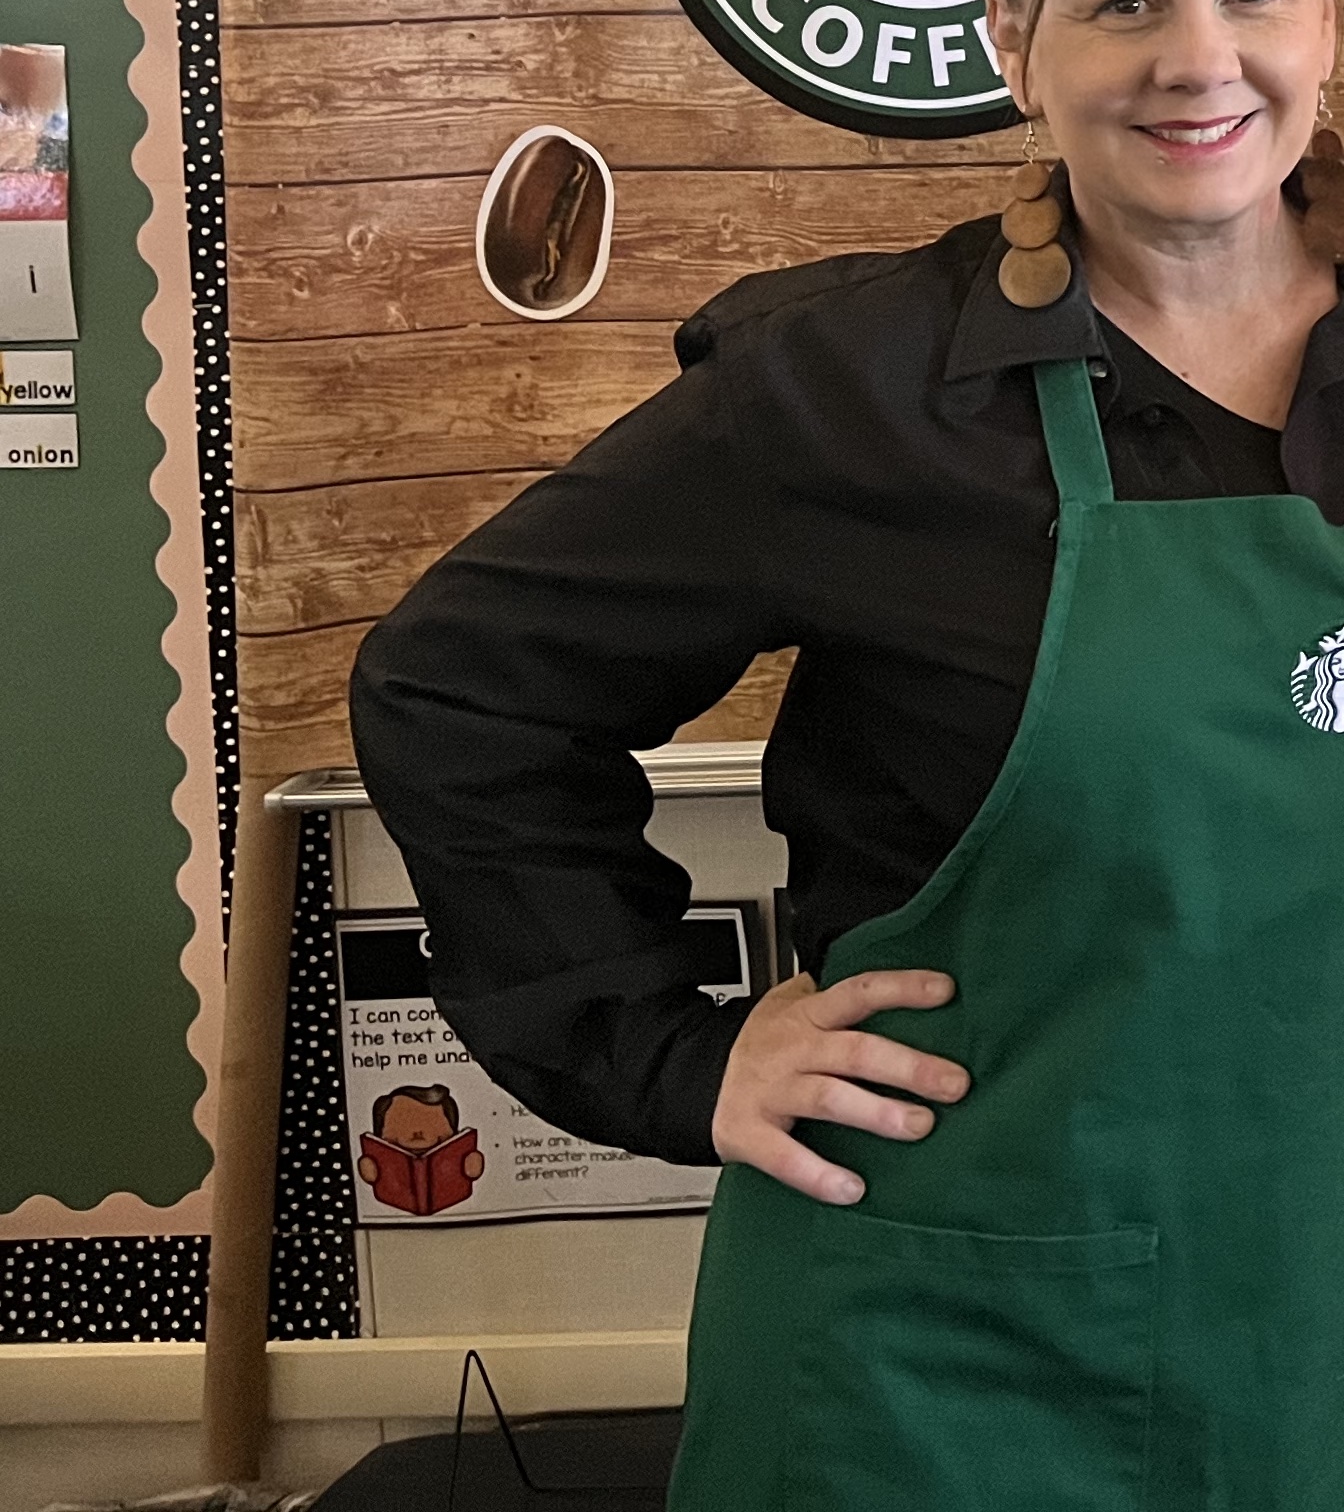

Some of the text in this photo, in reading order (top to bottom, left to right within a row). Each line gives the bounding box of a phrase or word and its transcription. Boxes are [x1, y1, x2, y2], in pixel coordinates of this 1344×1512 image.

[0, 381, 73, 404] yellow
[8, 444, 74, 464] onion
[349, 1008, 360, 1025] I
[366, 1010, 401, 1023] can
[351, 1030, 384, 1046] the
[391, 1028, 436, 1045] text
[351, 1051, 391, 1070] help
[398, 1053, 428, 1066] me
[513, 1136, 543, 1149] How
[515, 1151, 587, 1166] character
[515, 1165, 589, 1181] different?
